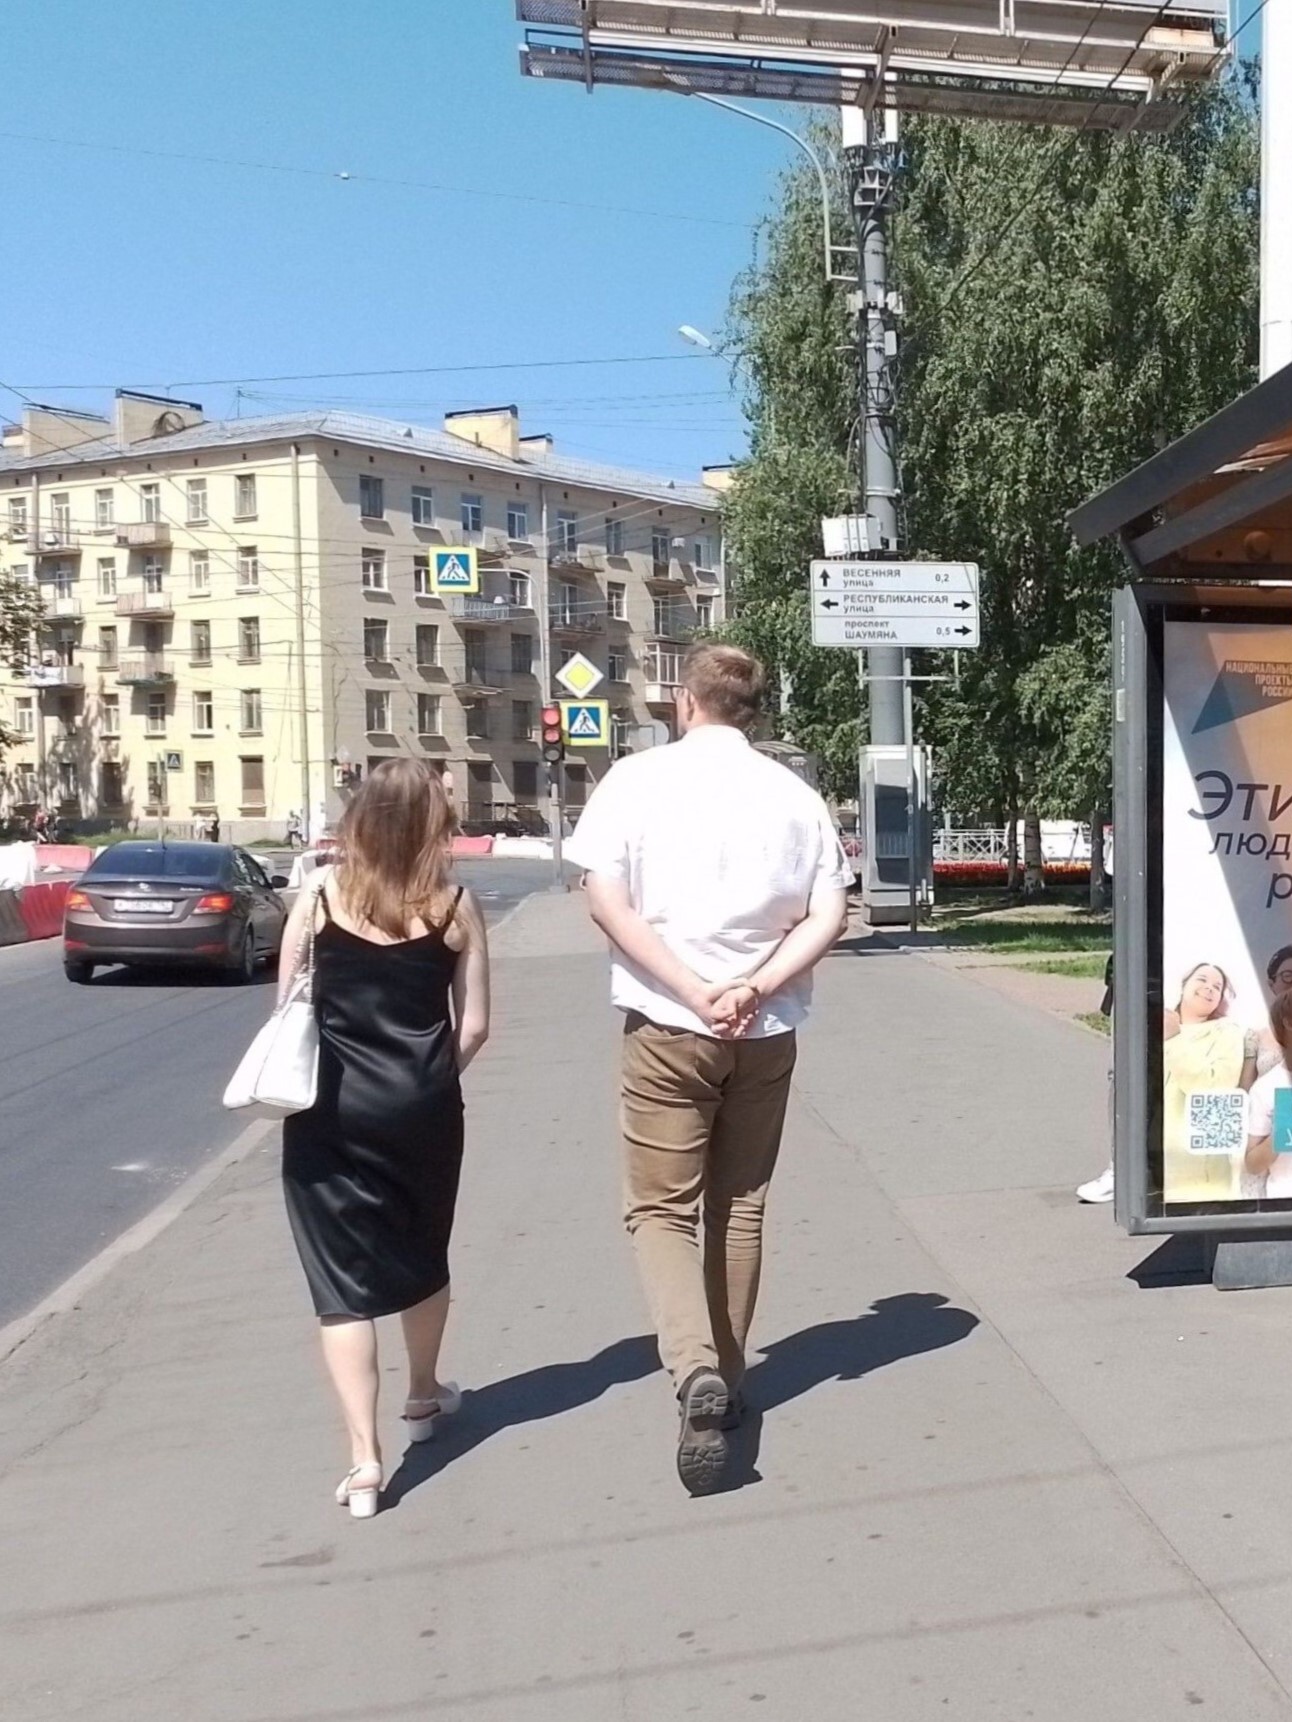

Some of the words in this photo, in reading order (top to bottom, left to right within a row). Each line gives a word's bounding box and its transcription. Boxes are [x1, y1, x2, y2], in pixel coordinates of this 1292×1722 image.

[843, 569, 901, 577] ВЕСЕННЯЯ
[935, 574, 949, 583] 0,2
[843, 595, 948, 603] РЕСПУБЛИКАНСКАЯ
[844, 606, 874, 614] улица
[845, 631, 898, 639] ШАУМЯНА
[936, 627, 951, 636] 0,5
